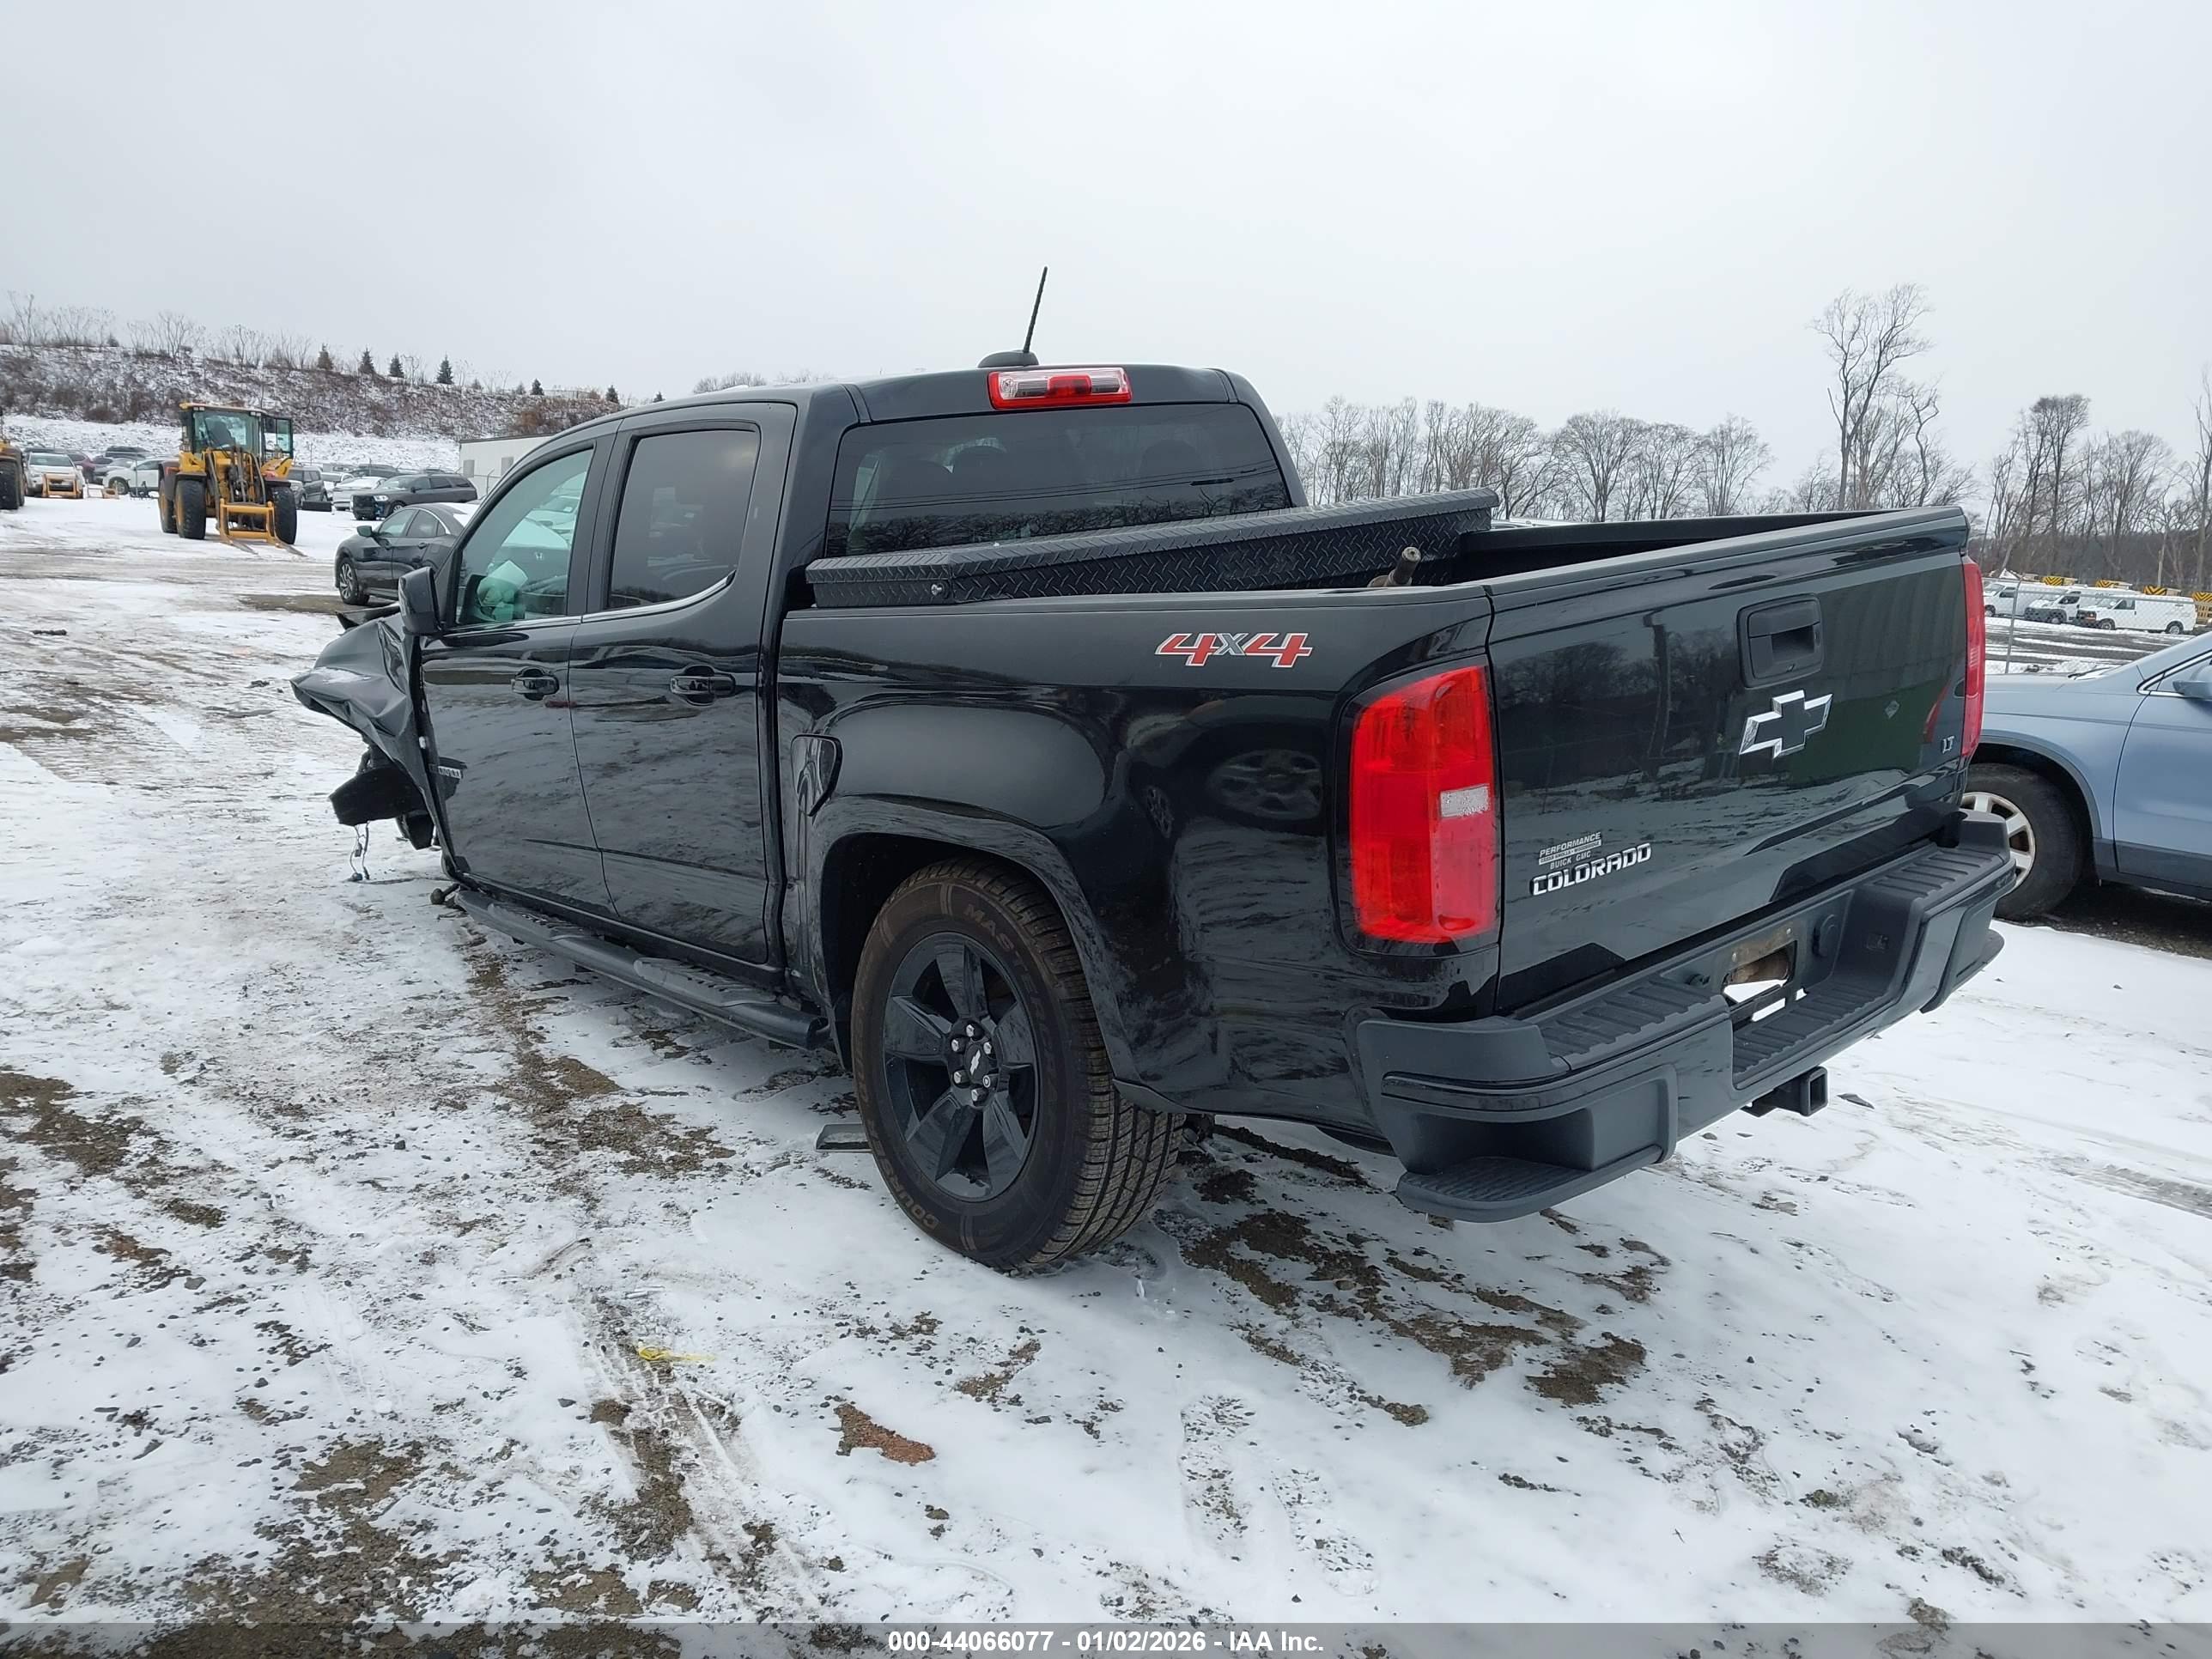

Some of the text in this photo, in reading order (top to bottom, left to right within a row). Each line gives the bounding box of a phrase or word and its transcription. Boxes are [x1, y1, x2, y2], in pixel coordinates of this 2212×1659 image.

[1942, 735, 1955, 755] LT
[1539, 831, 1601, 858] PERFORMANCE
[1531, 842, 1652, 896] COLORADO
[1550, 856, 1572, 870] BUICK
[1576, 850, 1592, 862] GMC
